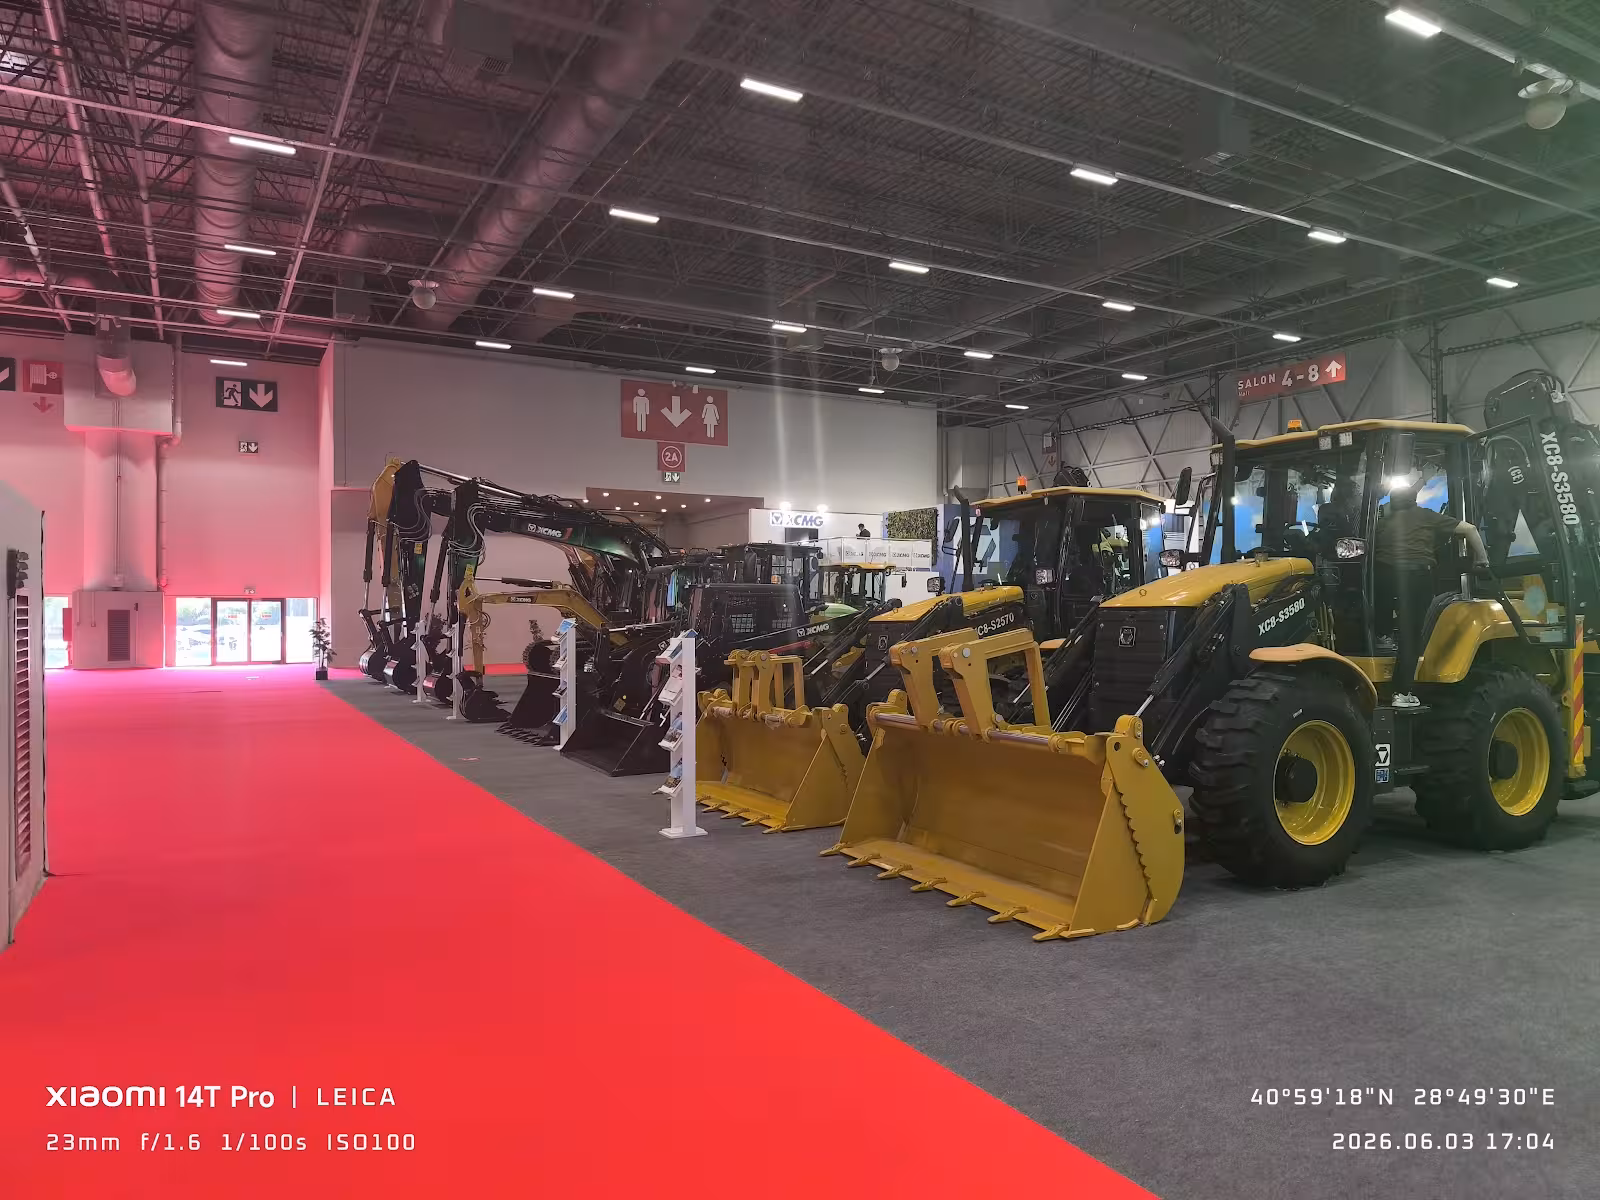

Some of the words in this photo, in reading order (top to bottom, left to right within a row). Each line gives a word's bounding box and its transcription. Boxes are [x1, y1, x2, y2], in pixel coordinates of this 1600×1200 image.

[1238, 373, 1276, 390] SALON
[665, 452, 679, 462] 2A
[1540, 431, 1580, 525] XC8-S3580
[786, 514, 824, 527] XCMG
[536, 526, 562, 538] XCMG
[975, 612, 1015, 636] C8-S2570
[1258, 597, 1305, 636] XC8-S3580
[806, 623, 830, 635] XCMG
